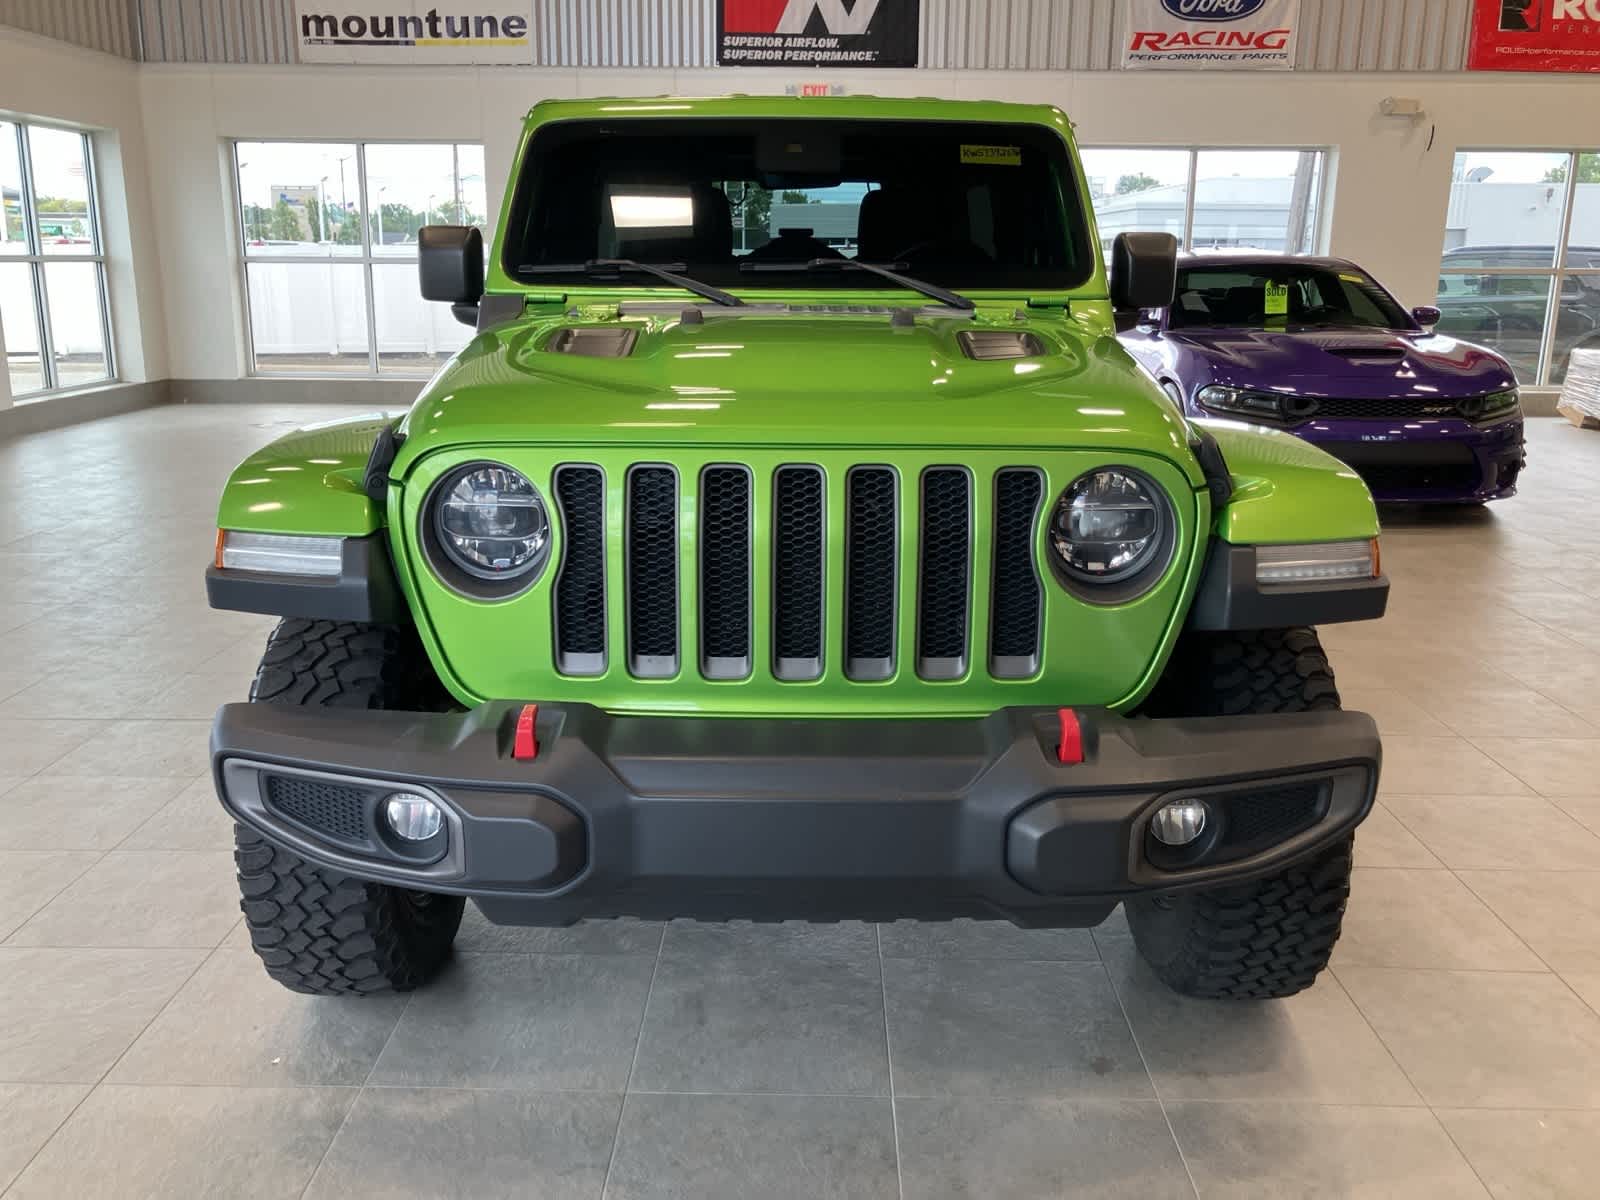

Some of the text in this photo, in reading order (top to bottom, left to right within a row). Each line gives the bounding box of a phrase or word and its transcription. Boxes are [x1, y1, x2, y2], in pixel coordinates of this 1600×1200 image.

[301, 8, 528, 38] mountune
[722, 36, 840, 48] SUPERIOR AIRFLOW.
[1130, 30, 1290, 52] RACING
[722, 49, 782, 60] SUPERIOR
